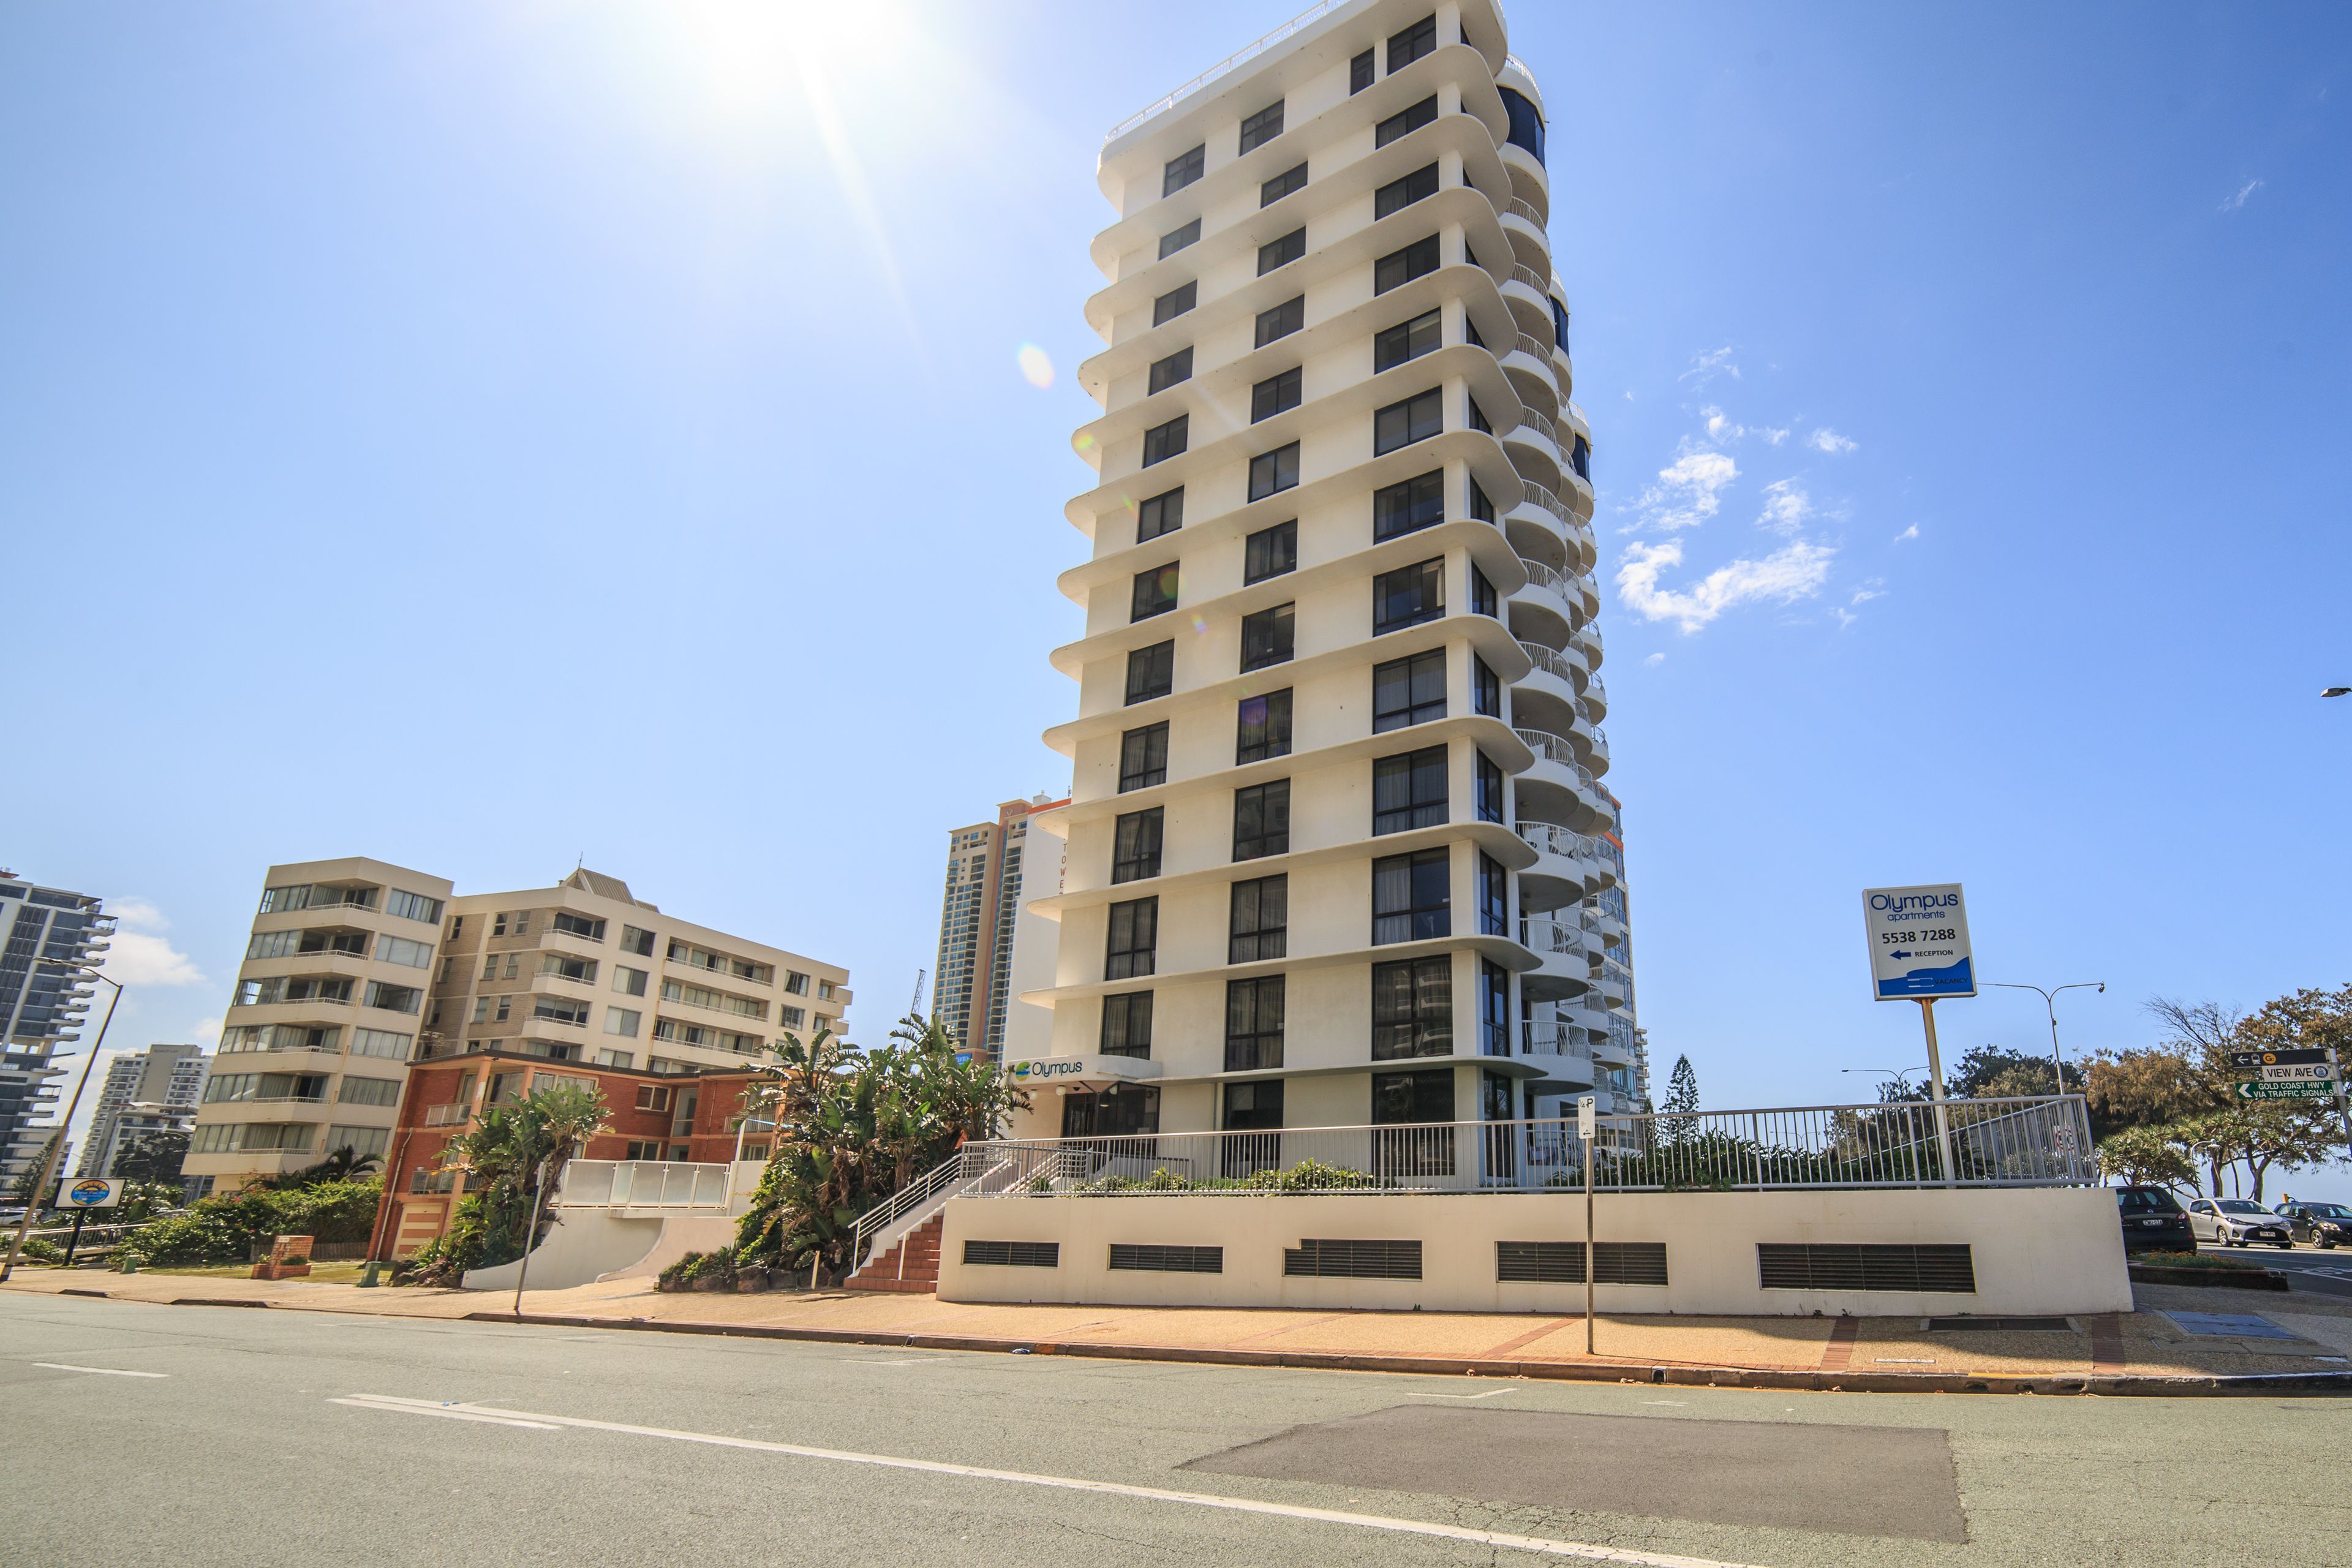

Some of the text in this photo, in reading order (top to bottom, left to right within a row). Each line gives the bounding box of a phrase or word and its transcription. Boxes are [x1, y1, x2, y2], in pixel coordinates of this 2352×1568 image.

[1871, 894, 1958, 913] Olympus
[1887, 911, 1945, 922] apartments
[1882, 929, 1956, 944] 5538 7288
[1032, 1061, 1082, 1077] Olympus
[2266, 1068, 2313, 1078] VIEW AVE
